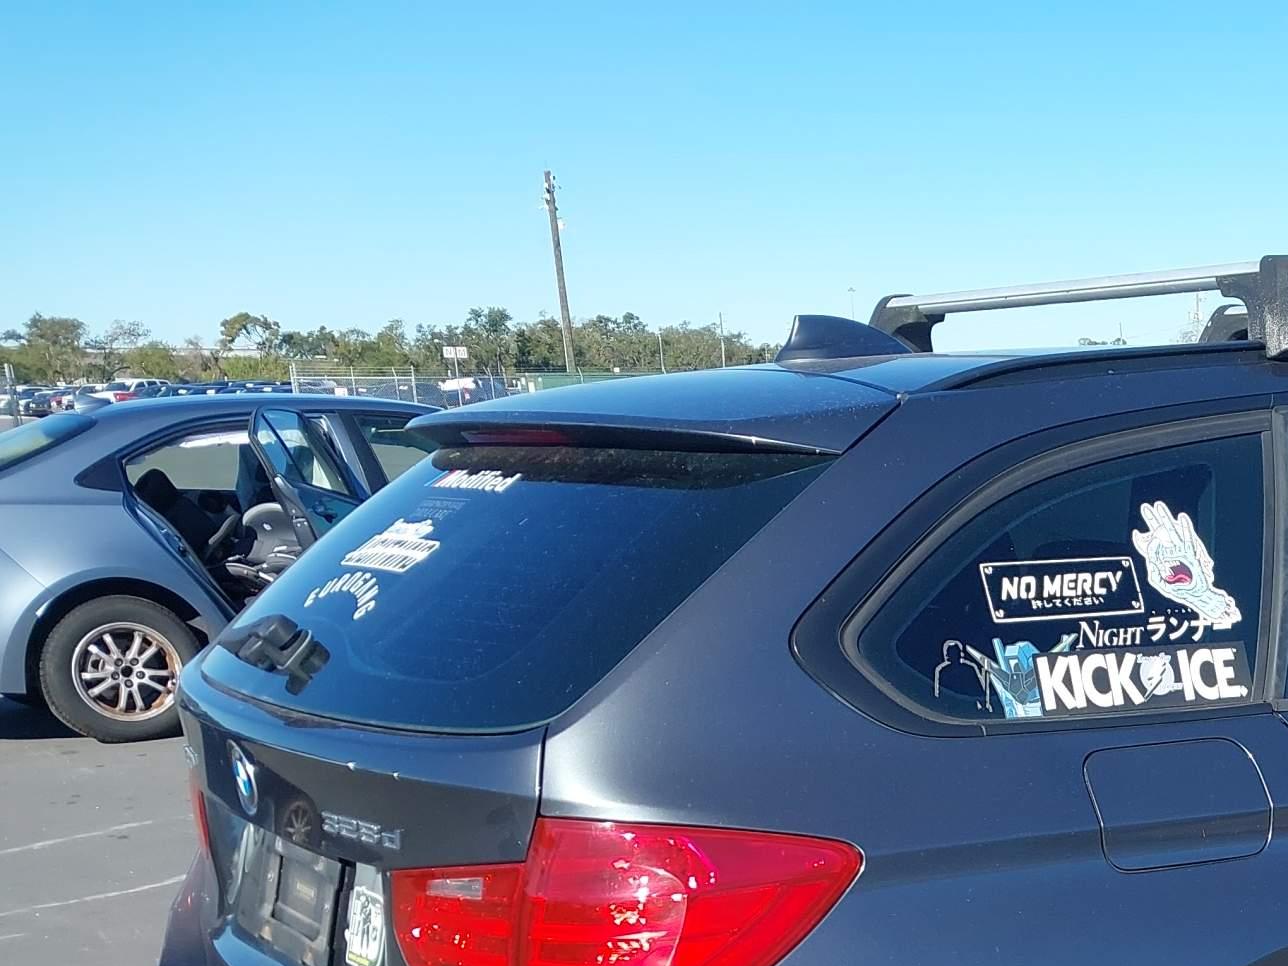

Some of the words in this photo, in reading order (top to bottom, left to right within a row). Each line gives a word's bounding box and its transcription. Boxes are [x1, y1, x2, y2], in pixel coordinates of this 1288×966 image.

[432, 469, 522, 493] Modified
[1001, 573, 1036, 600] NO
[1043, 571, 1122, 598] MERCY
[1036, 652, 1145, 711] KICK
